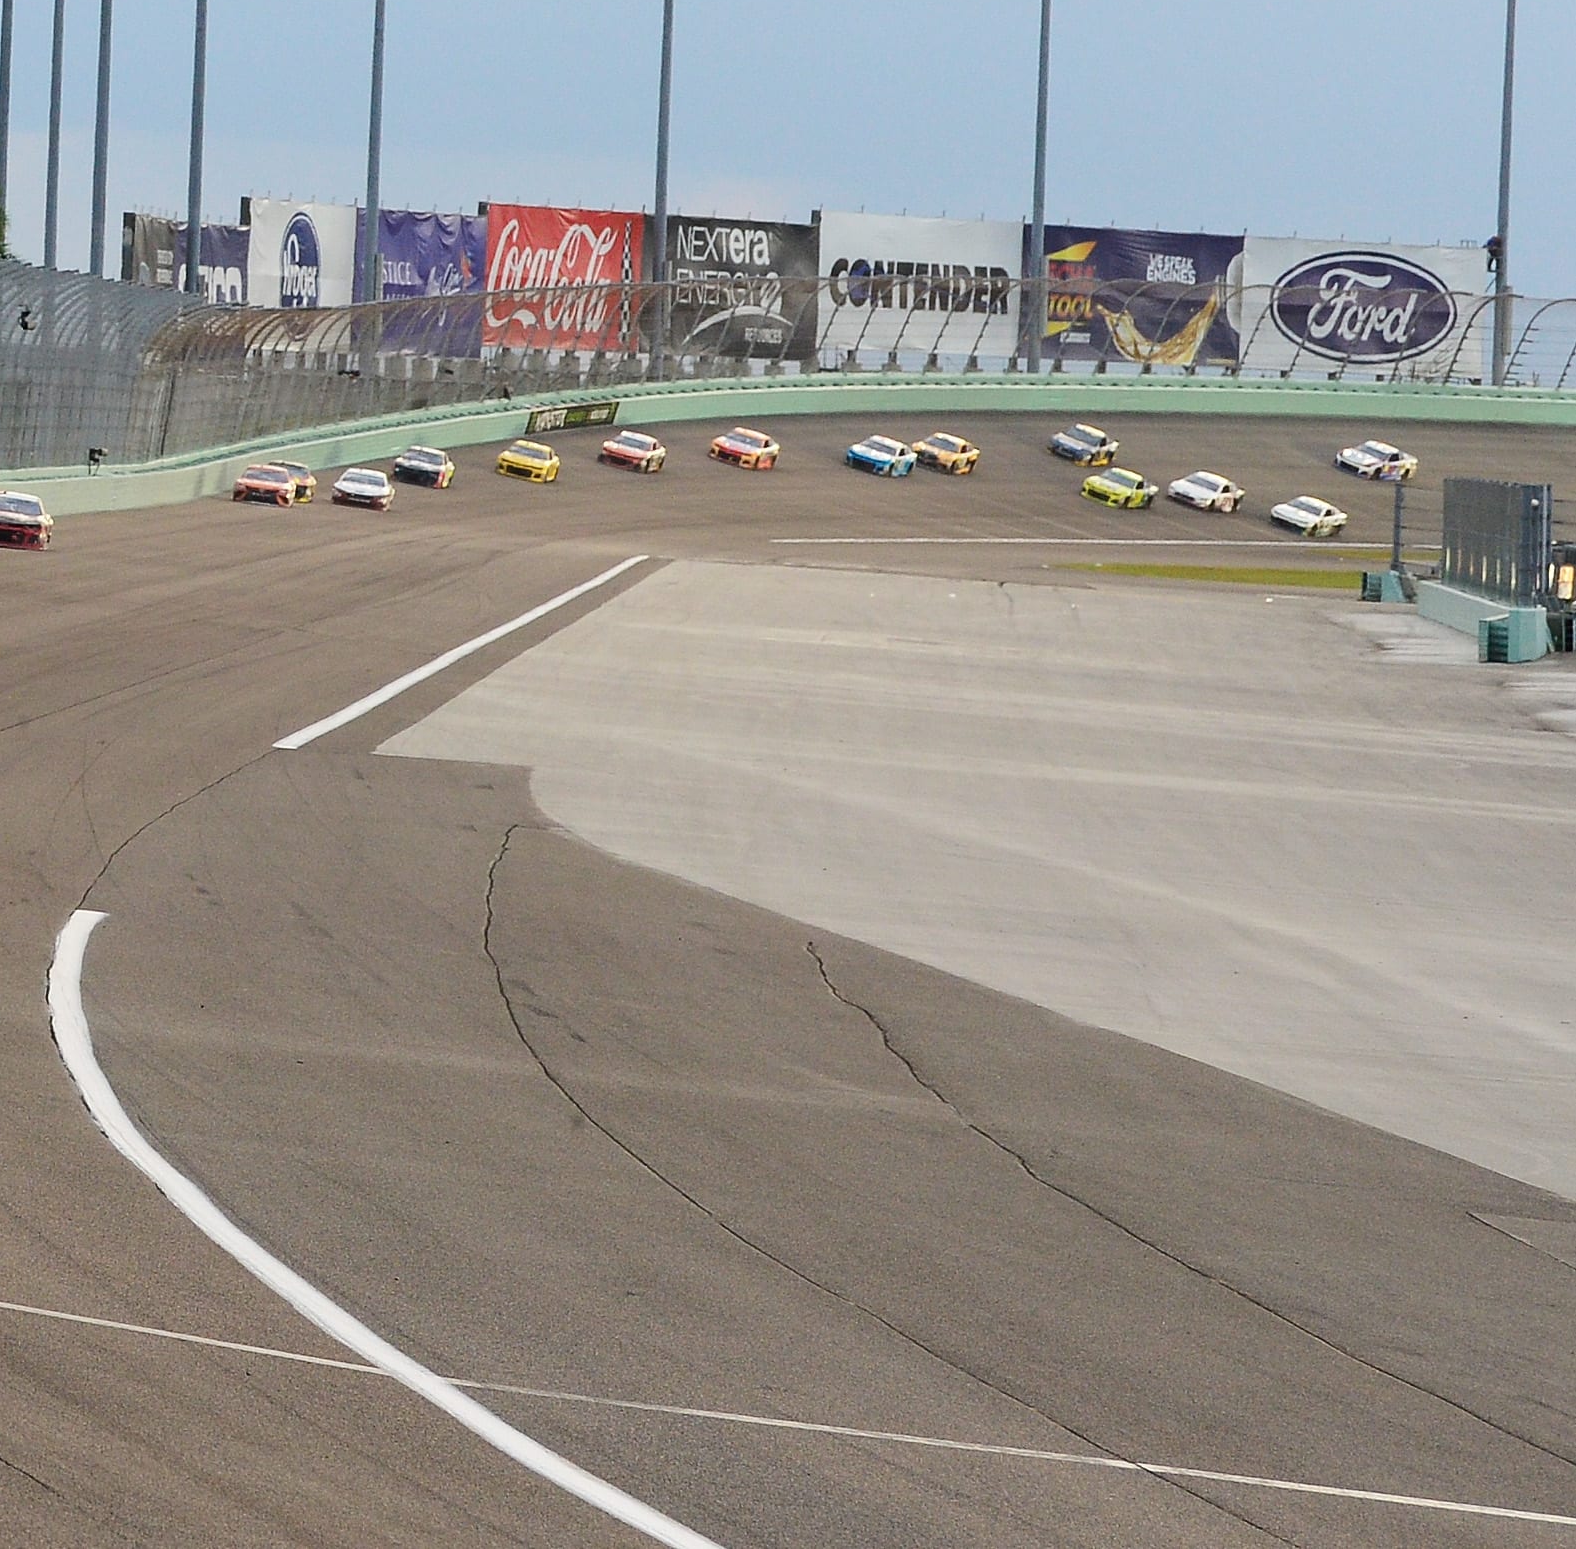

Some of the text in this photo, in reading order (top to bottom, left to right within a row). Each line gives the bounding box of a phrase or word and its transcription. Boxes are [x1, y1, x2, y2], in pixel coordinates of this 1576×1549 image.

[676, 225, 770, 265] NEXTera
[829, 258, 1010, 315] CONTENDER
[1146, 266, 1197, 285] ENGINES
[1307, 267, 1416, 344] Ford
